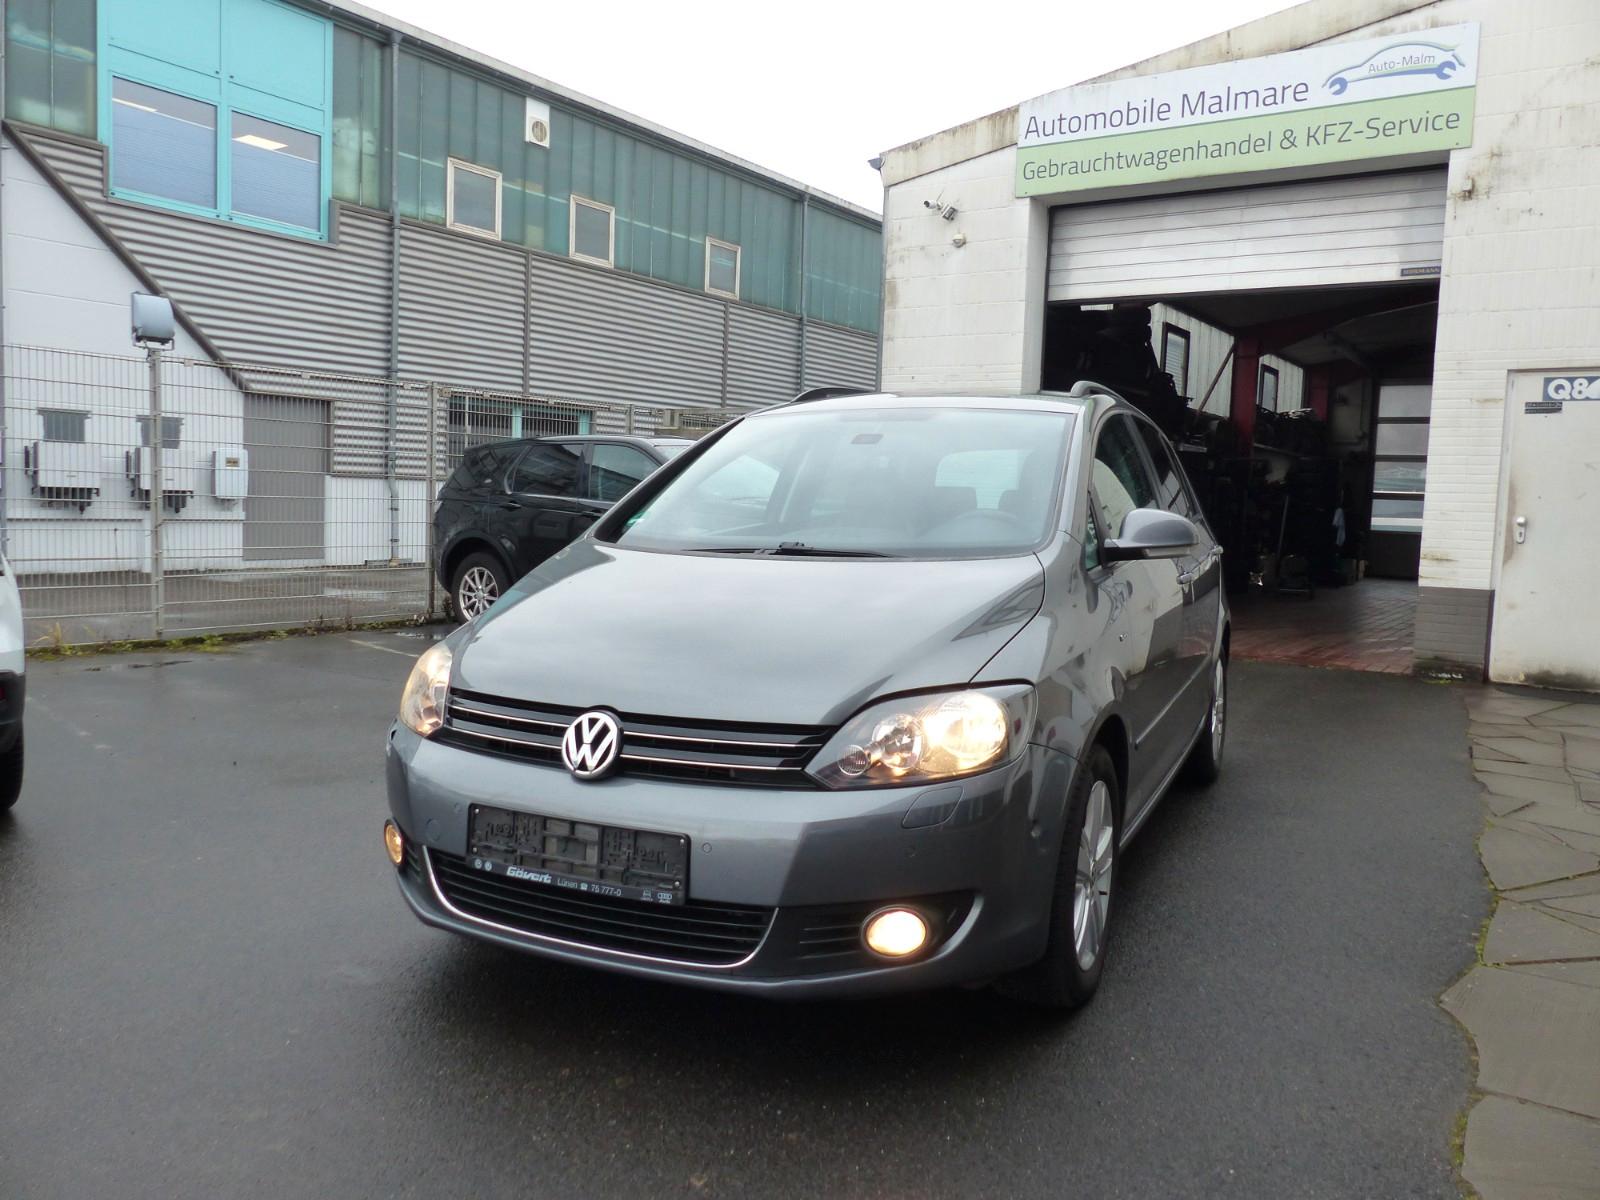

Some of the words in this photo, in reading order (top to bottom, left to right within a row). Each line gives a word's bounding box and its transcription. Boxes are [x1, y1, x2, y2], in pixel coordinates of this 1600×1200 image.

[1368, 52, 1436, 74] Auto-Malm
[1023, 97, 1172, 140] Automobile
[1181, 81, 1310, 119] Malmare
[1022, 130, 1273, 181] Gebrauchtwagenhandel
[1279, 128, 1298, 150] &
[1306, 110, 1461, 147] KFZ-Service
[1547, 377, 1589, 400] Q8
[562, 711, 619, 776] VW
